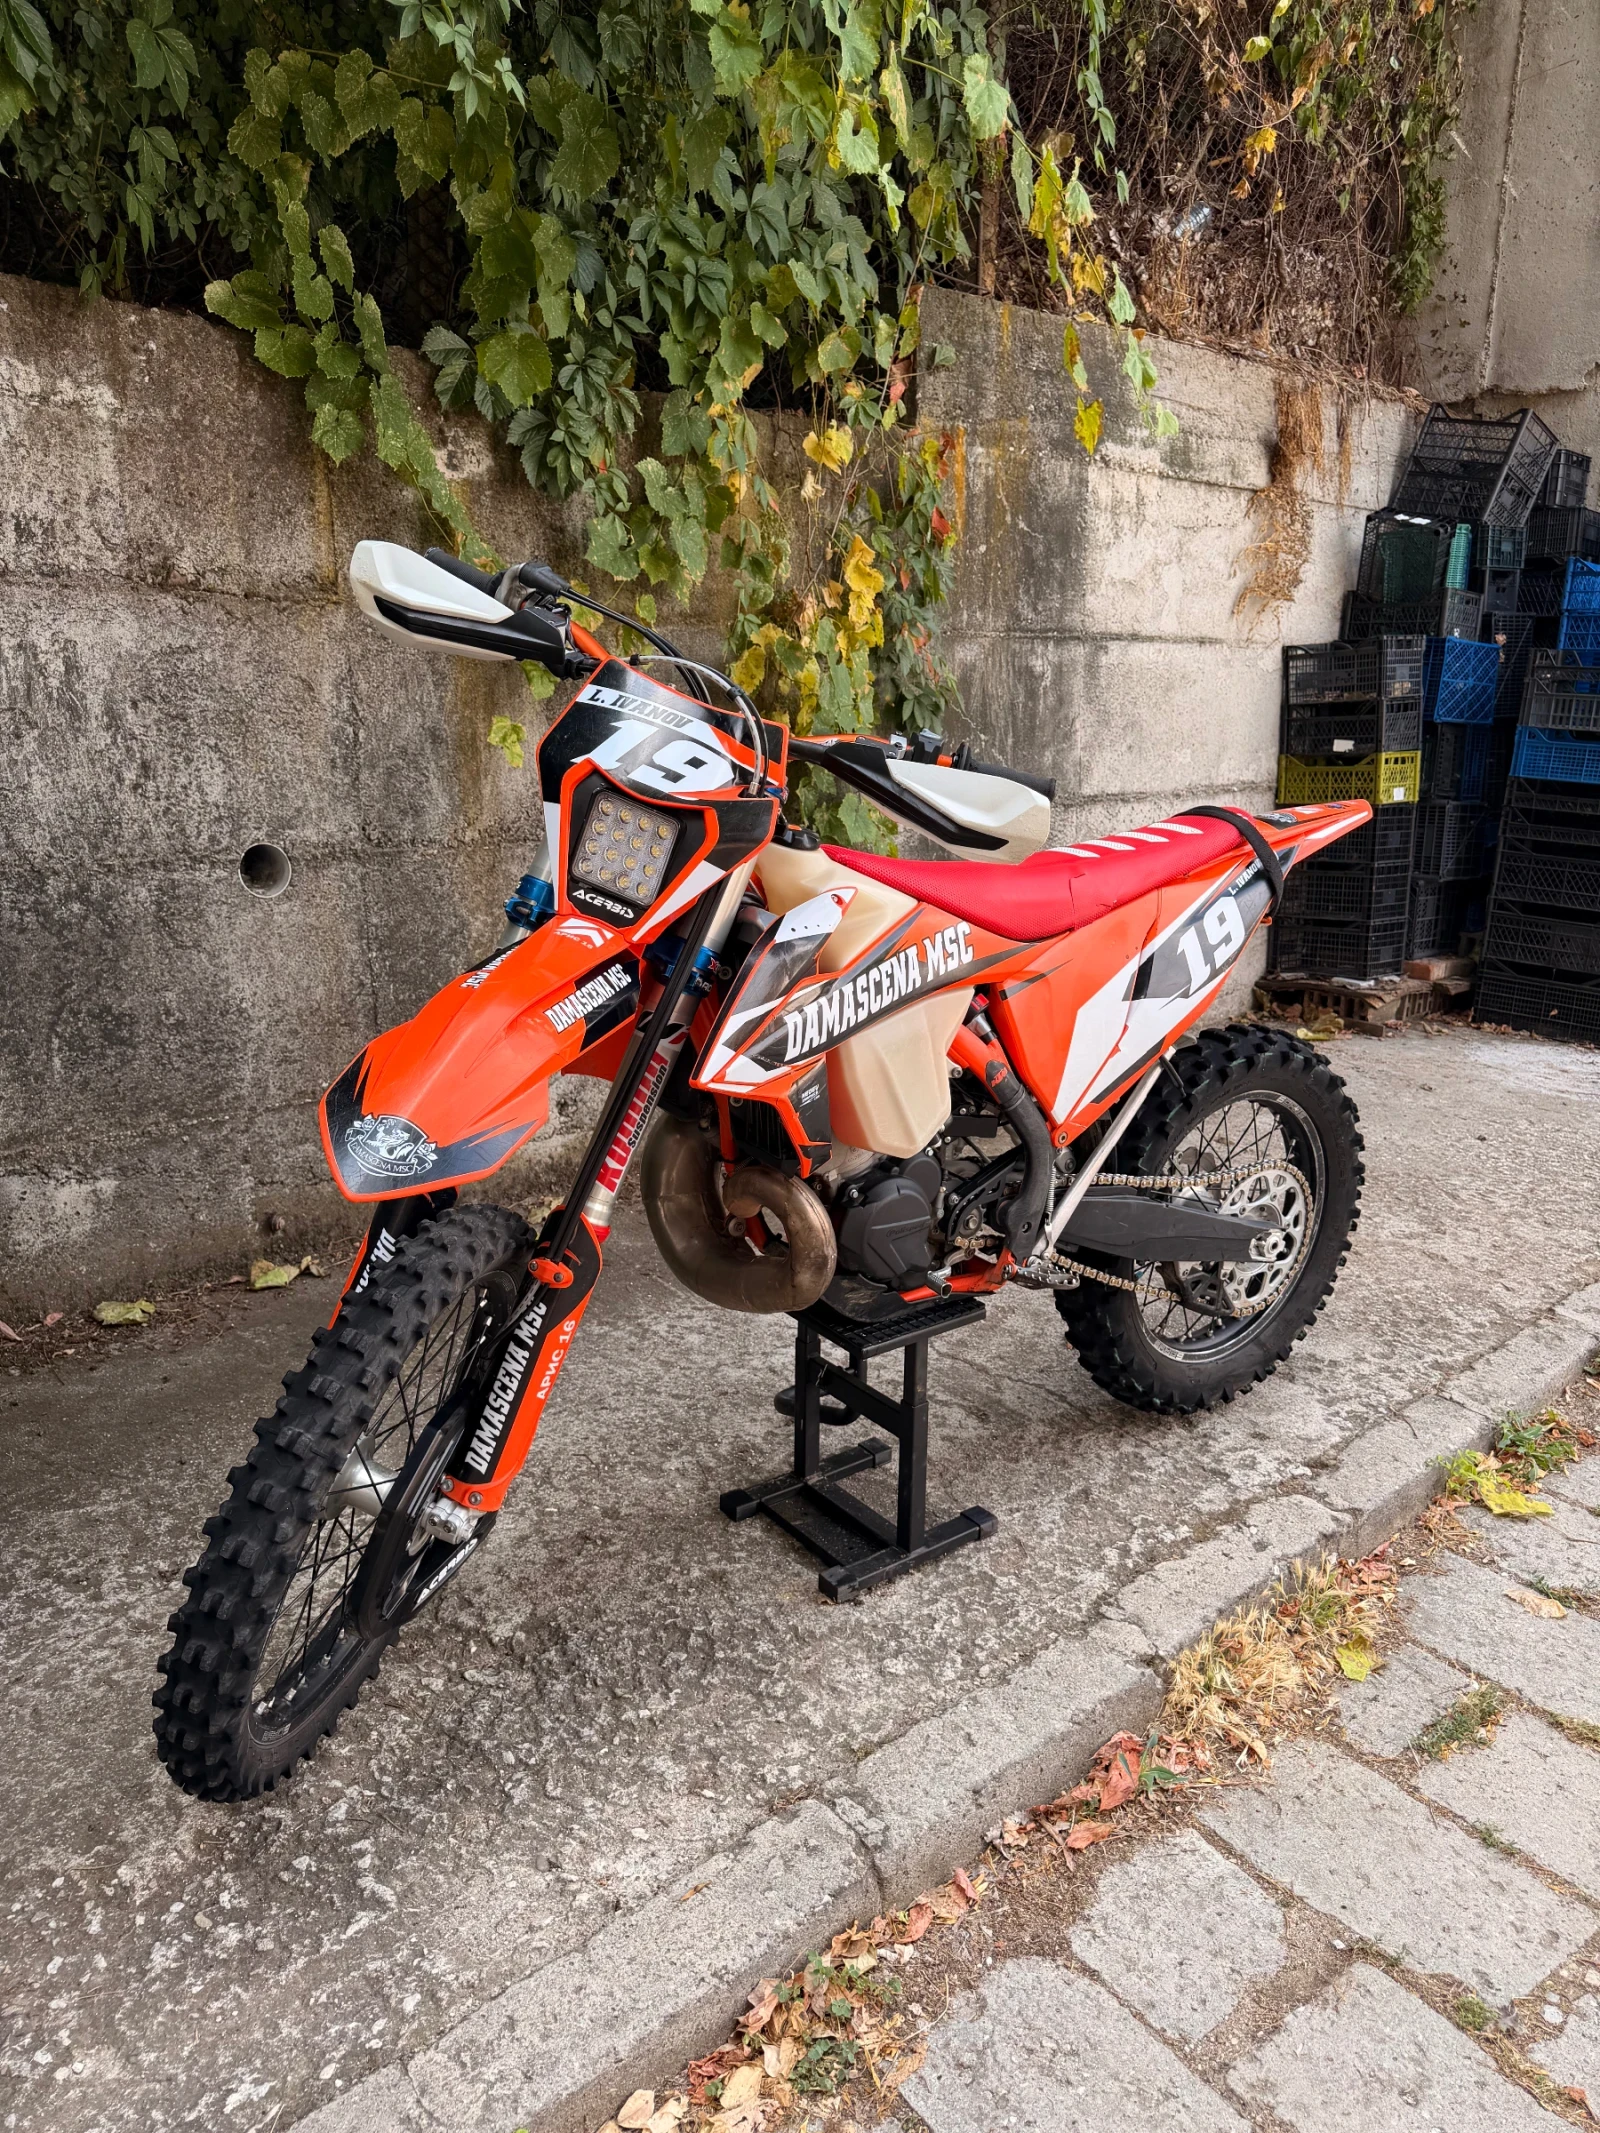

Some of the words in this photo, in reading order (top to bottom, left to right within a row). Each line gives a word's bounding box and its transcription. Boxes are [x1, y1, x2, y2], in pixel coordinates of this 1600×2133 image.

[588, 688, 605, 704] L.
[611, 693, 694, 729] IVANOV
[570, 718, 735, 793] 19
[572, 888, 635, 919] ACERBIS
[1228, 886, 1239, 896] L.
[1175, 896, 1246, 993] 19
[544, 971, 615, 1034] DAMASCENA
[608, 963, 632, 992] MSC
[783, 945, 922, 1063] DAMASCENA
[922, 920, 975, 982] MSC
[350, 1140, 392, 1171] DAMASCENA
[393, 1164, 414, 1174] MSC
[560, 1320, 576, 1344] 16
[465, 1340, 530, 1476] DAMASCENA
[514, 1301, 548, 1348] MSC
[416, 1537, 478, 1604] ACERBIS
